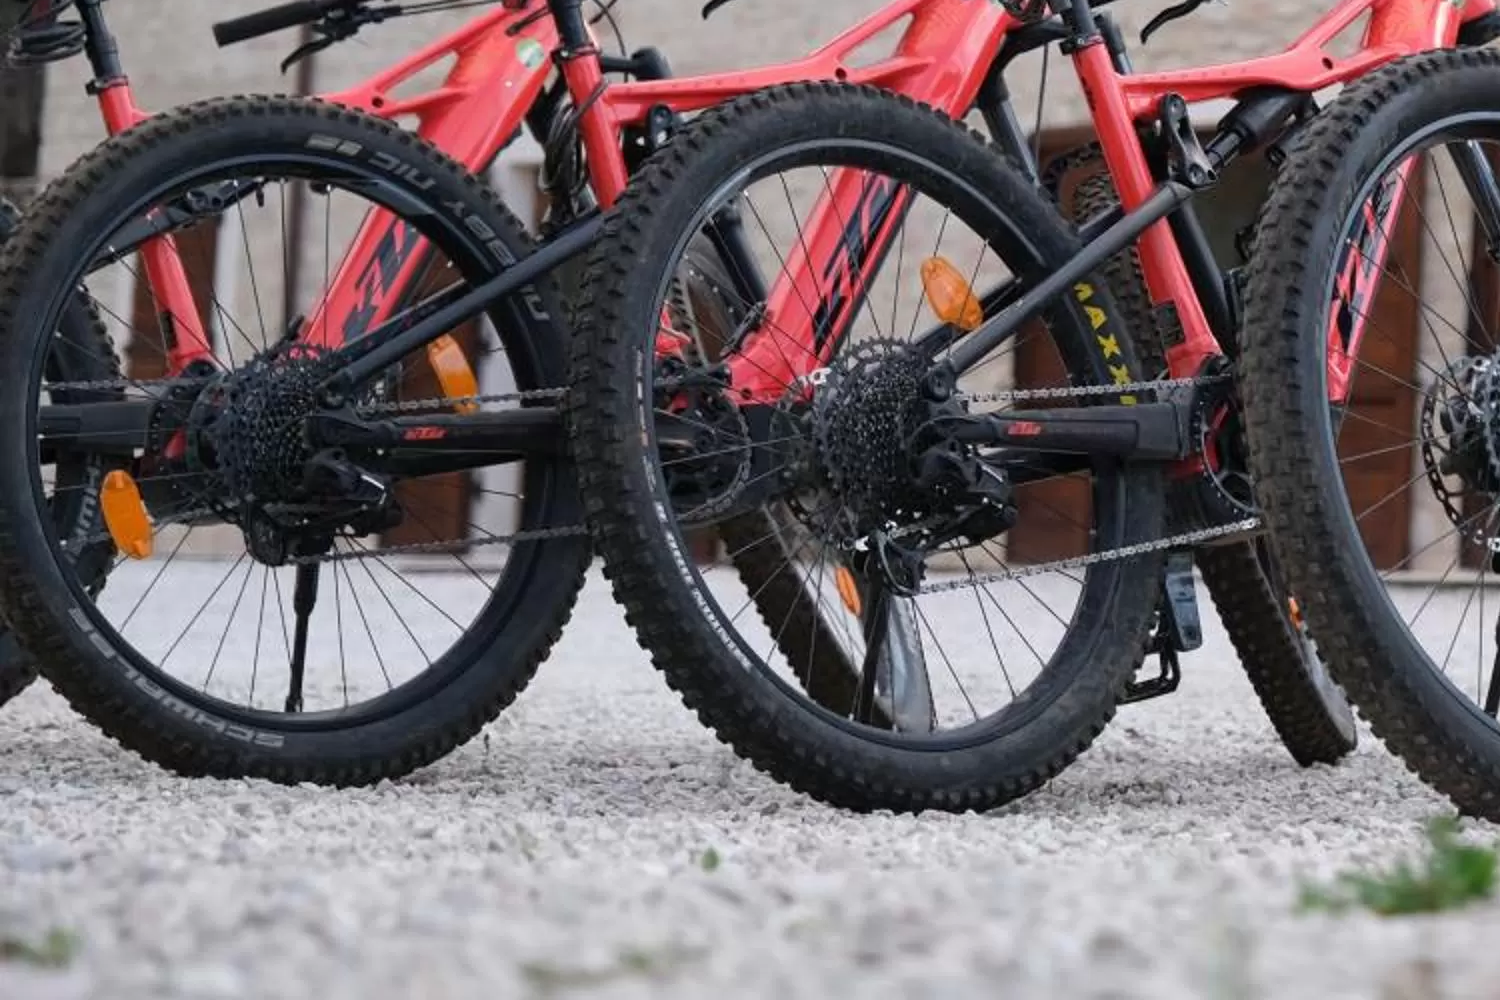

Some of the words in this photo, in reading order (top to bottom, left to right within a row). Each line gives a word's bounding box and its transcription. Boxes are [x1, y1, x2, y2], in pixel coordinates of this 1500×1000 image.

[367, 151, 437, 190] NIC
[445, 201, 550, 321] NBBY
[1072, 282, 1137, 407] MAXXI
